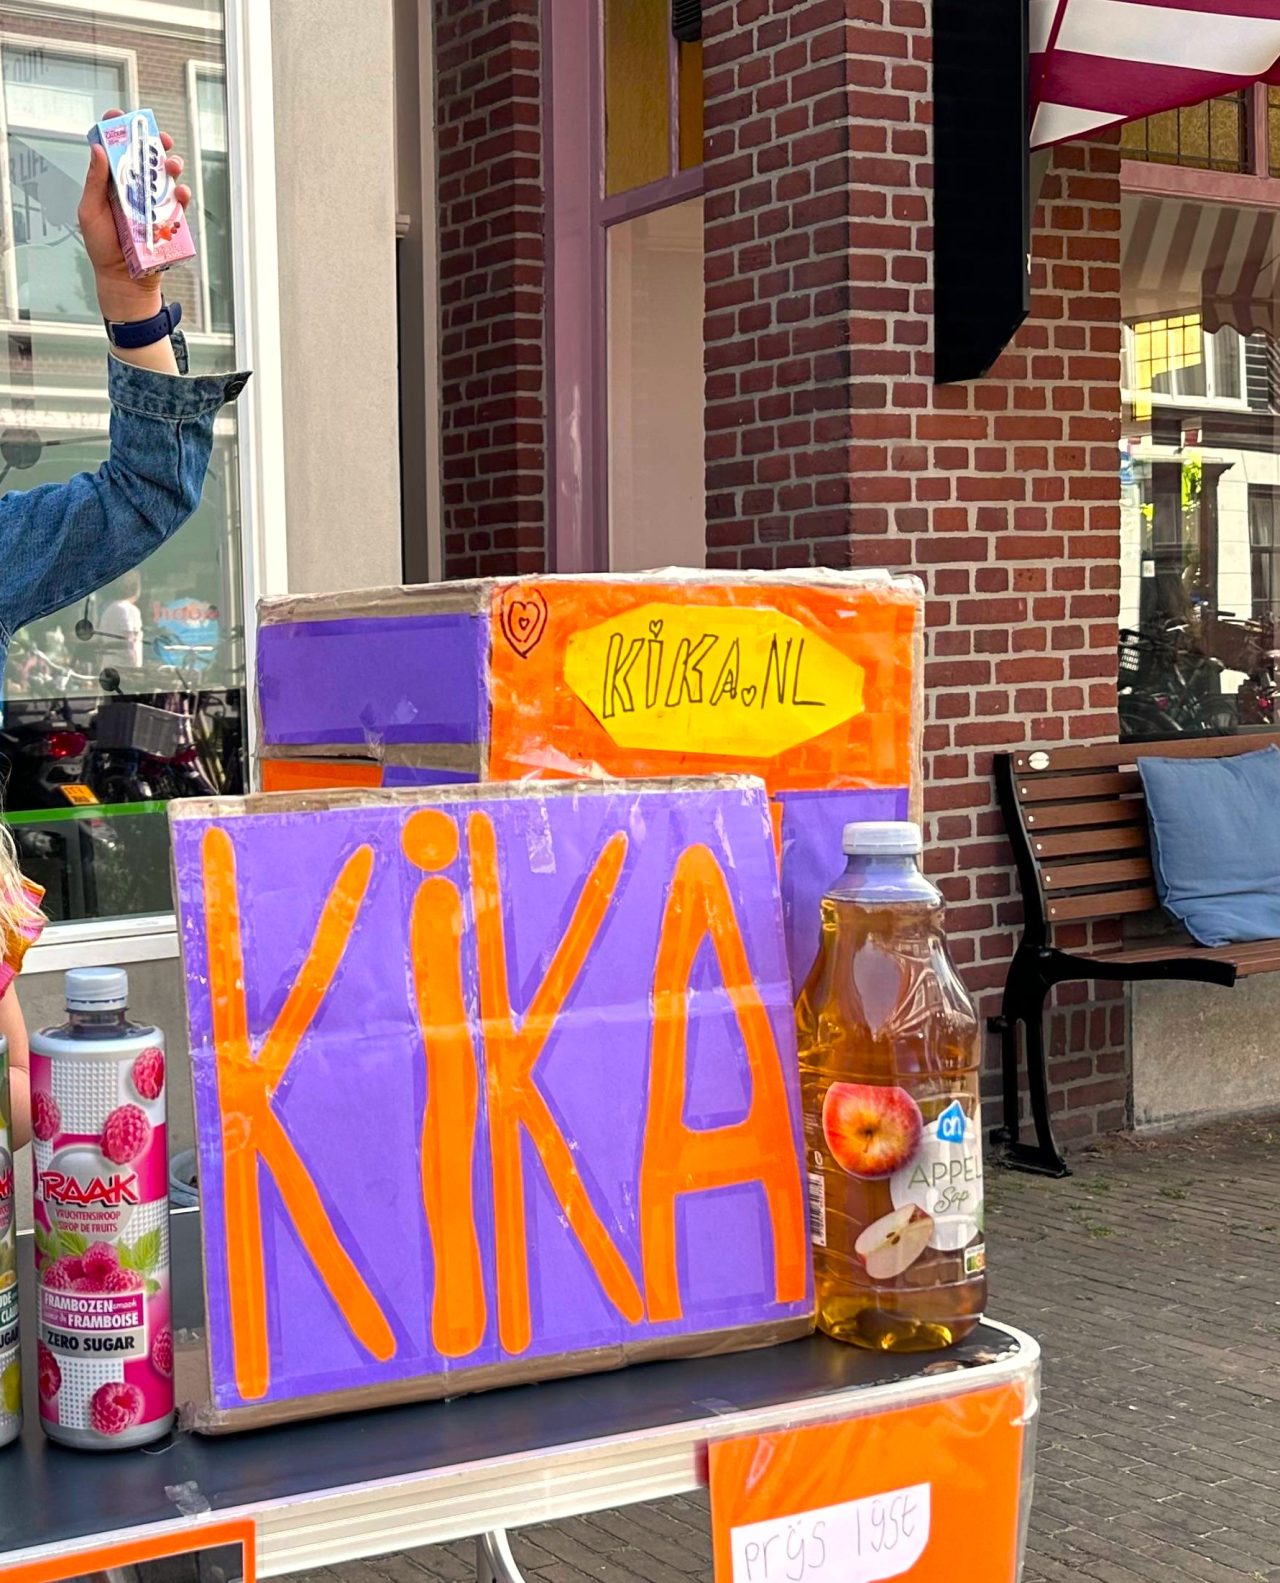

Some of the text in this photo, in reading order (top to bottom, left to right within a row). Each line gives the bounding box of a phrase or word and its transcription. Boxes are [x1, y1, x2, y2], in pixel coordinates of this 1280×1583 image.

[908, 1157, 982, 1189] APPEL
[41, 1171, 140, 1207] RAAK
[933, 1186, 970, 1214] Sap
[55, 1208, 121, 1221] VRUCHTENSIROOP
[58, 1222, 118, 1233] SIROP DE FRUITS
[68, 1312, 139, 1329] FRAMBOISE
[47, 1331, 135, 1352] ZERO SUGAR
